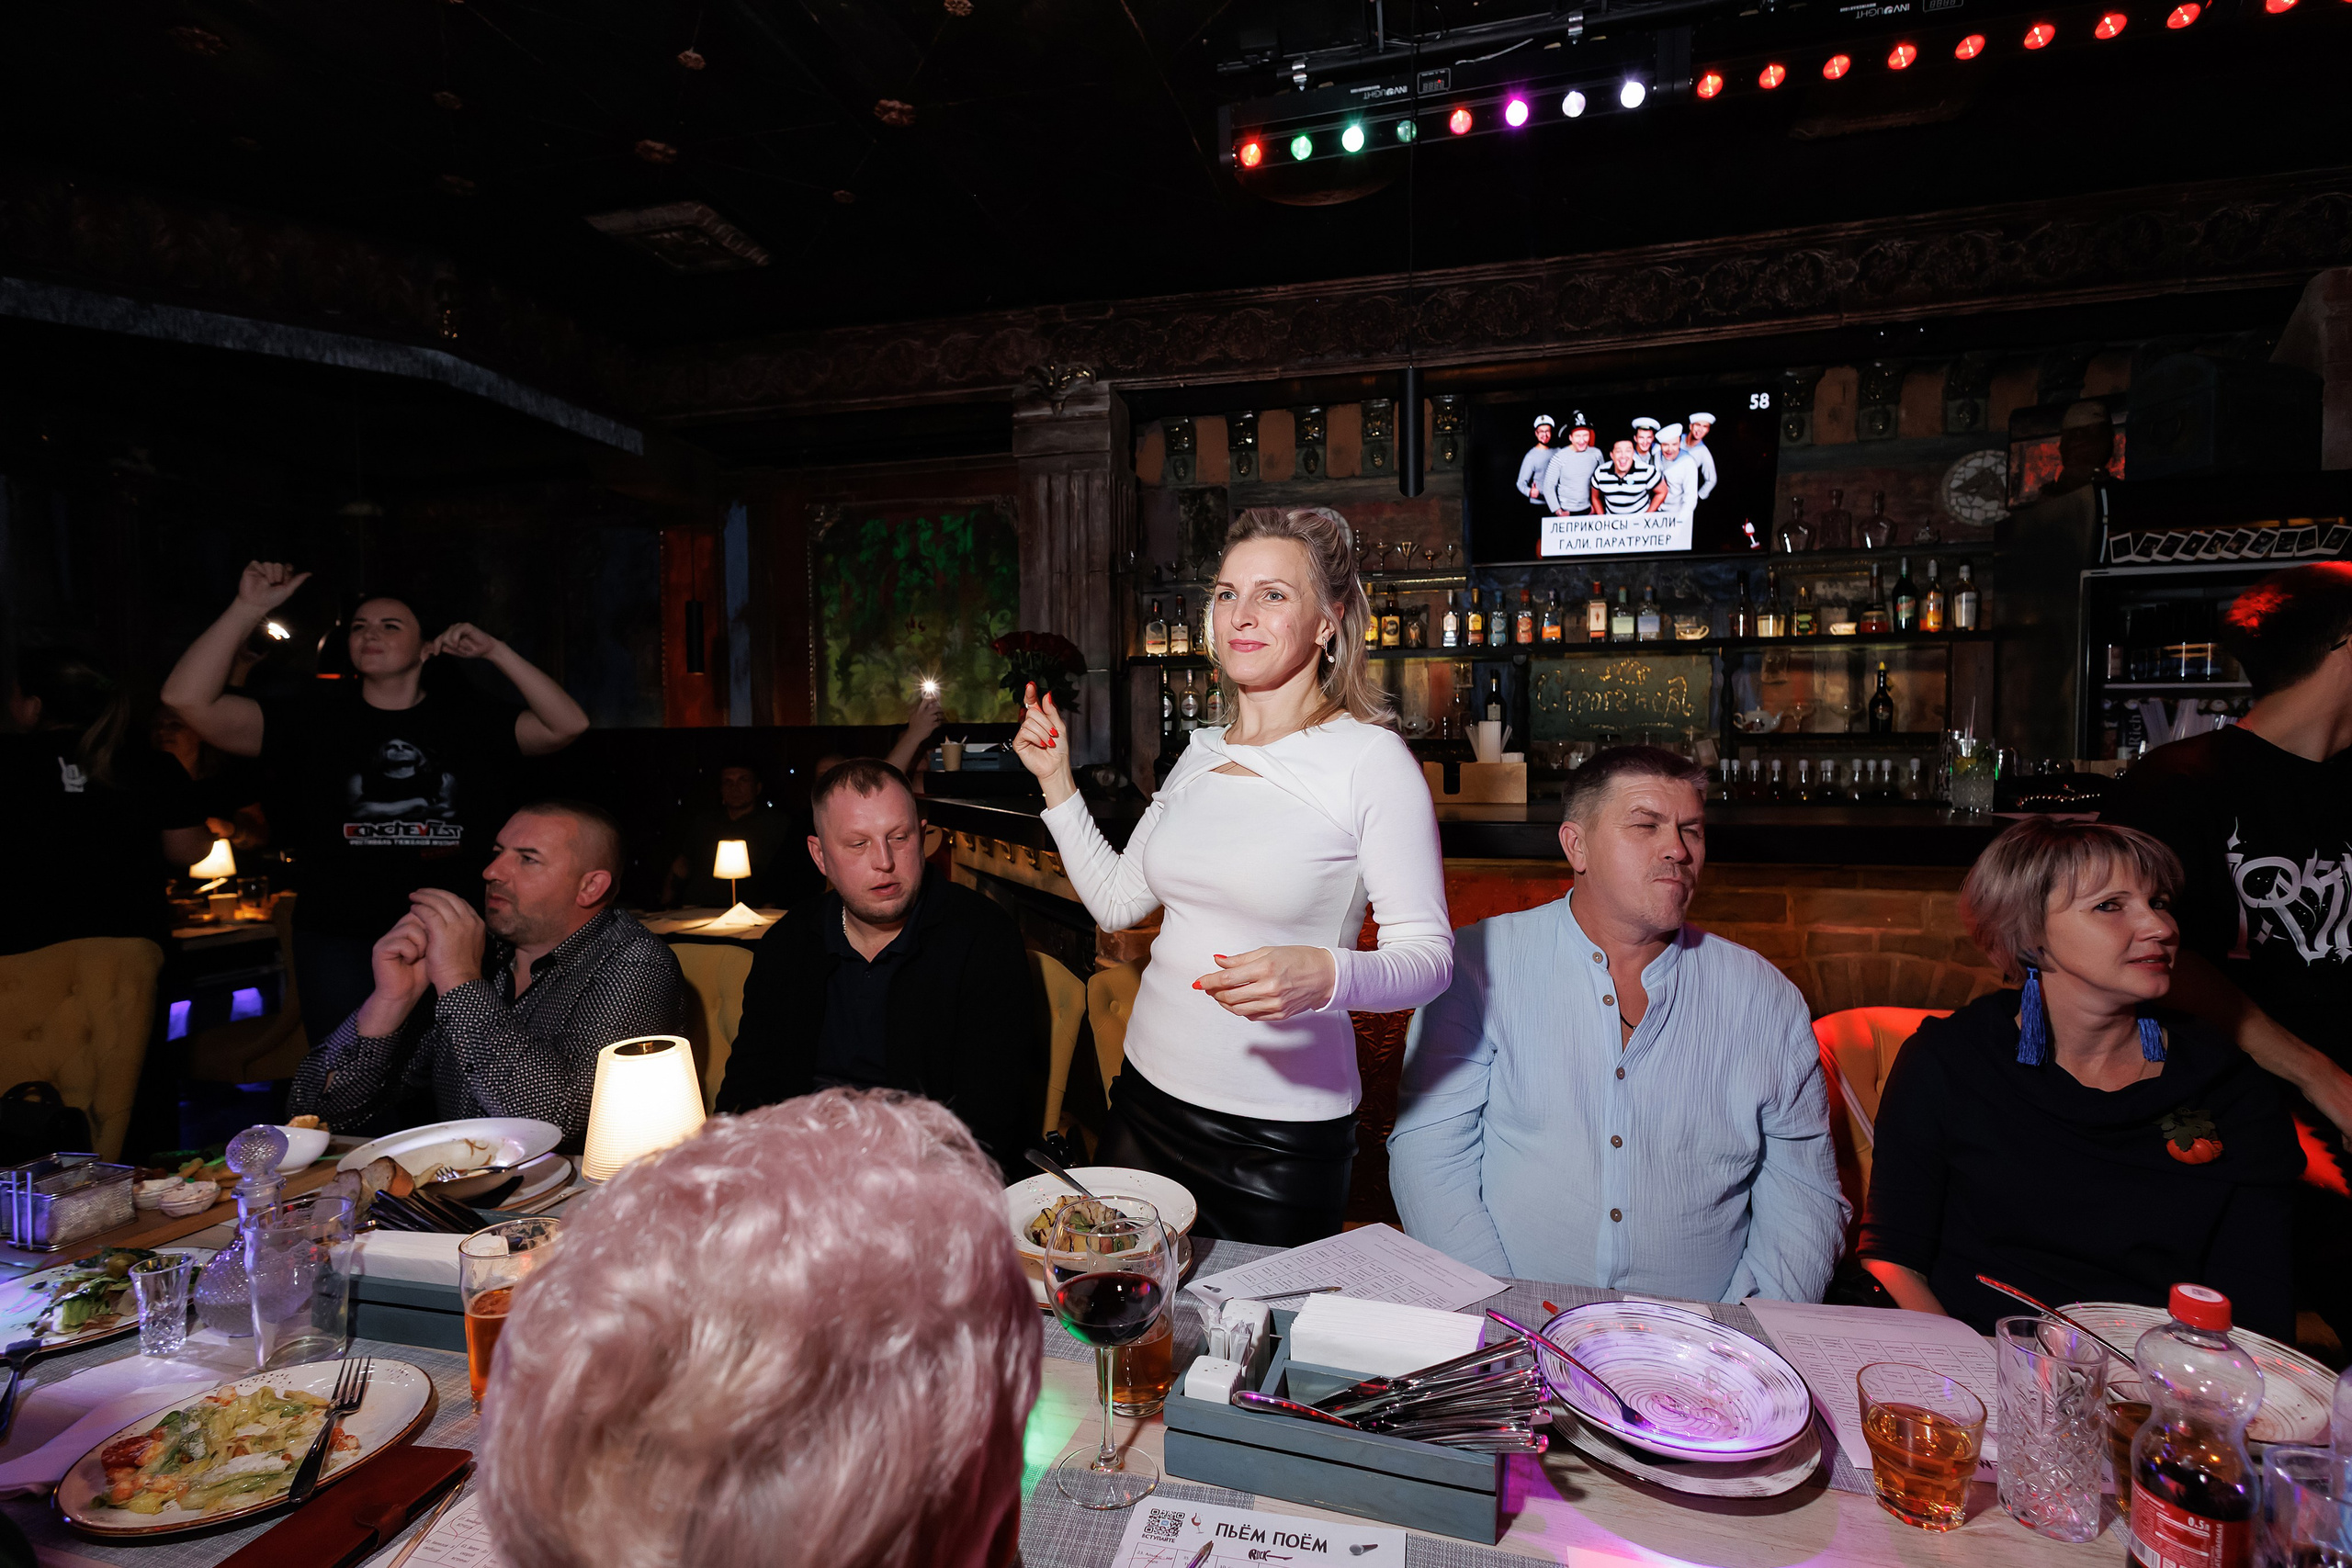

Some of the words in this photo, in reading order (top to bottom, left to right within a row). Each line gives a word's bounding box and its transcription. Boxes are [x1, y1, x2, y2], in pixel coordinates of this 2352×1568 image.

[1749, 392, 1770, 411] 58
[1550, 519, 1628, 534] ЛЕПРИКОНСЫ
[1595, 534, 1672, 548] ПАРАТРУПЕР
[2128, 713, 2143, 748] Rich
[1141, 1533, 1176, 1543] ВСТУПАЙТЕ
[1215, 1522, 1266, 1543] ПЬЁМ
[1272, 1531, 1328, 1553] ПОЁМ
